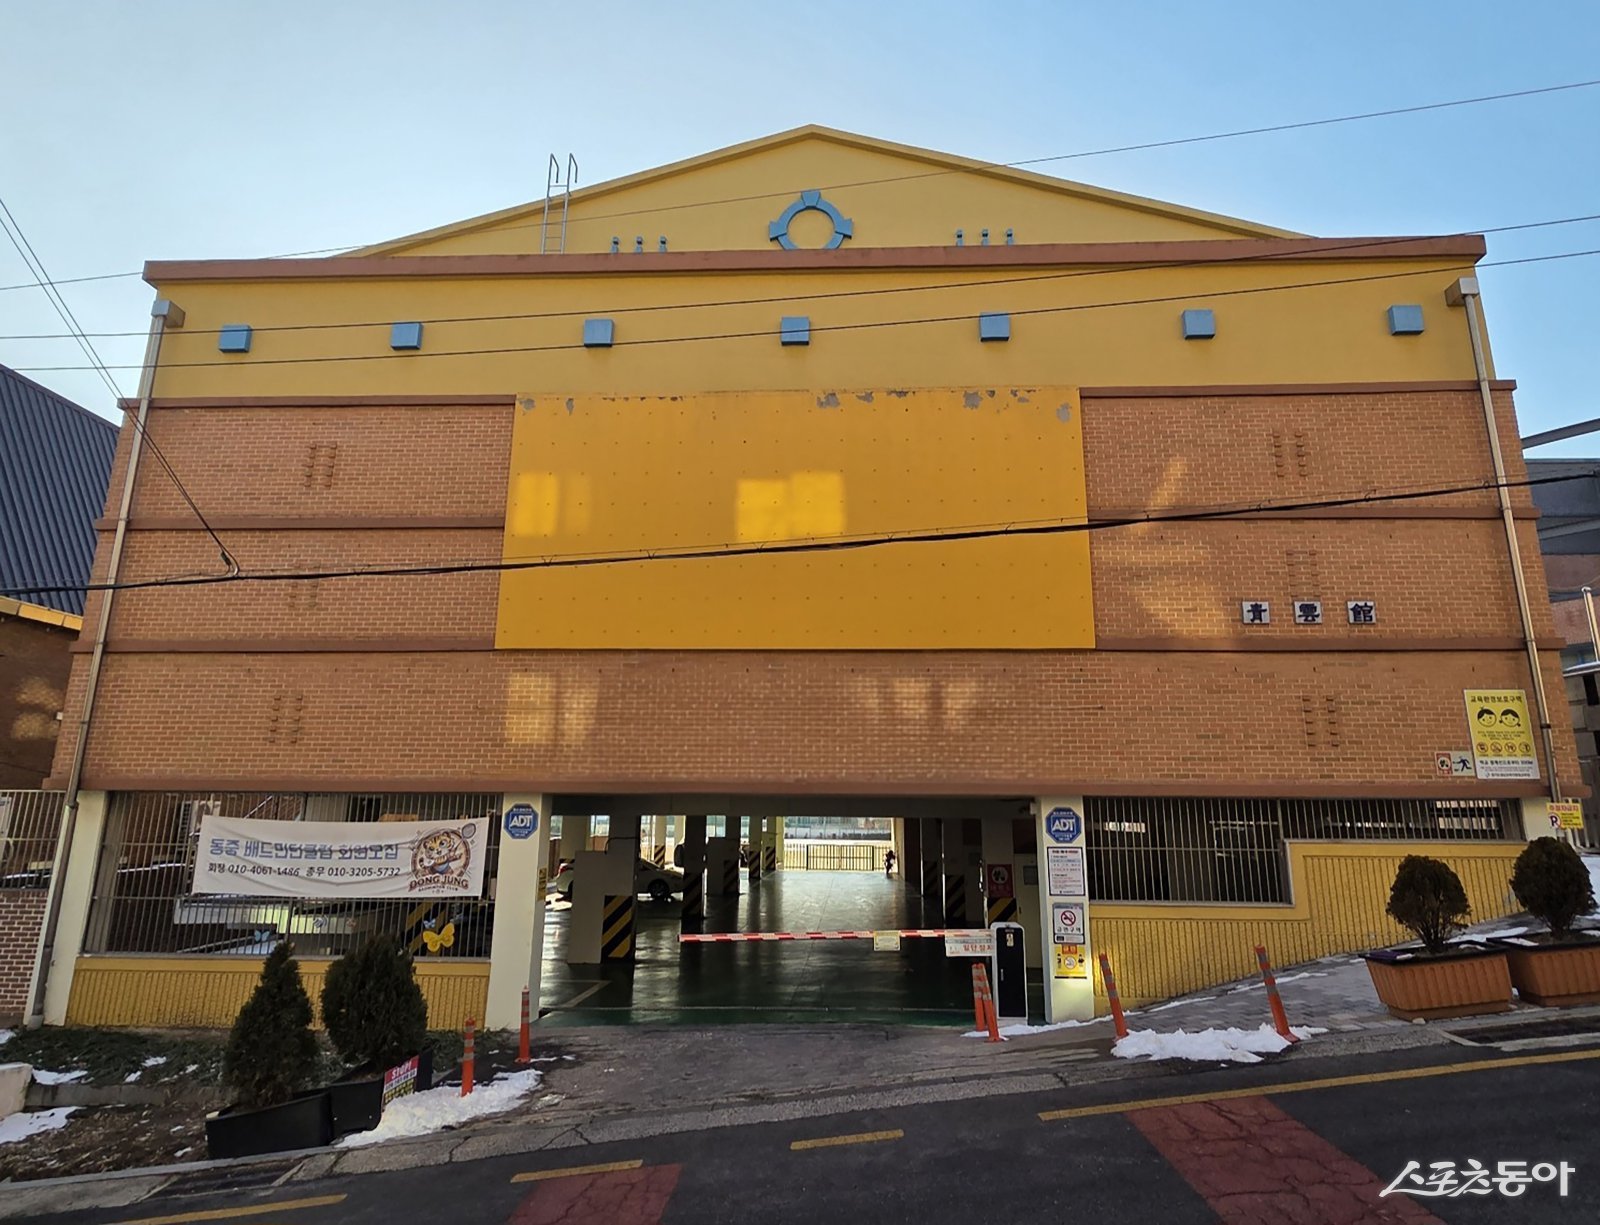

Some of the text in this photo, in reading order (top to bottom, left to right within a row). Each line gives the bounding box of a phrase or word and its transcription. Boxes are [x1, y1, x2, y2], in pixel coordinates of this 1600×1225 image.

[510, 815, 533, 827] ADT
[1052, 819, 1075, 831] ADT
[209, 838, 240, 857] 동중
[243, 840, 333, 860] 배드민턴클럽
[306, 865, 326, 877] 총무
[327, 866, 401, 877] 010-3205-5732
[408, 875, 469, 891] DONG JUNG
